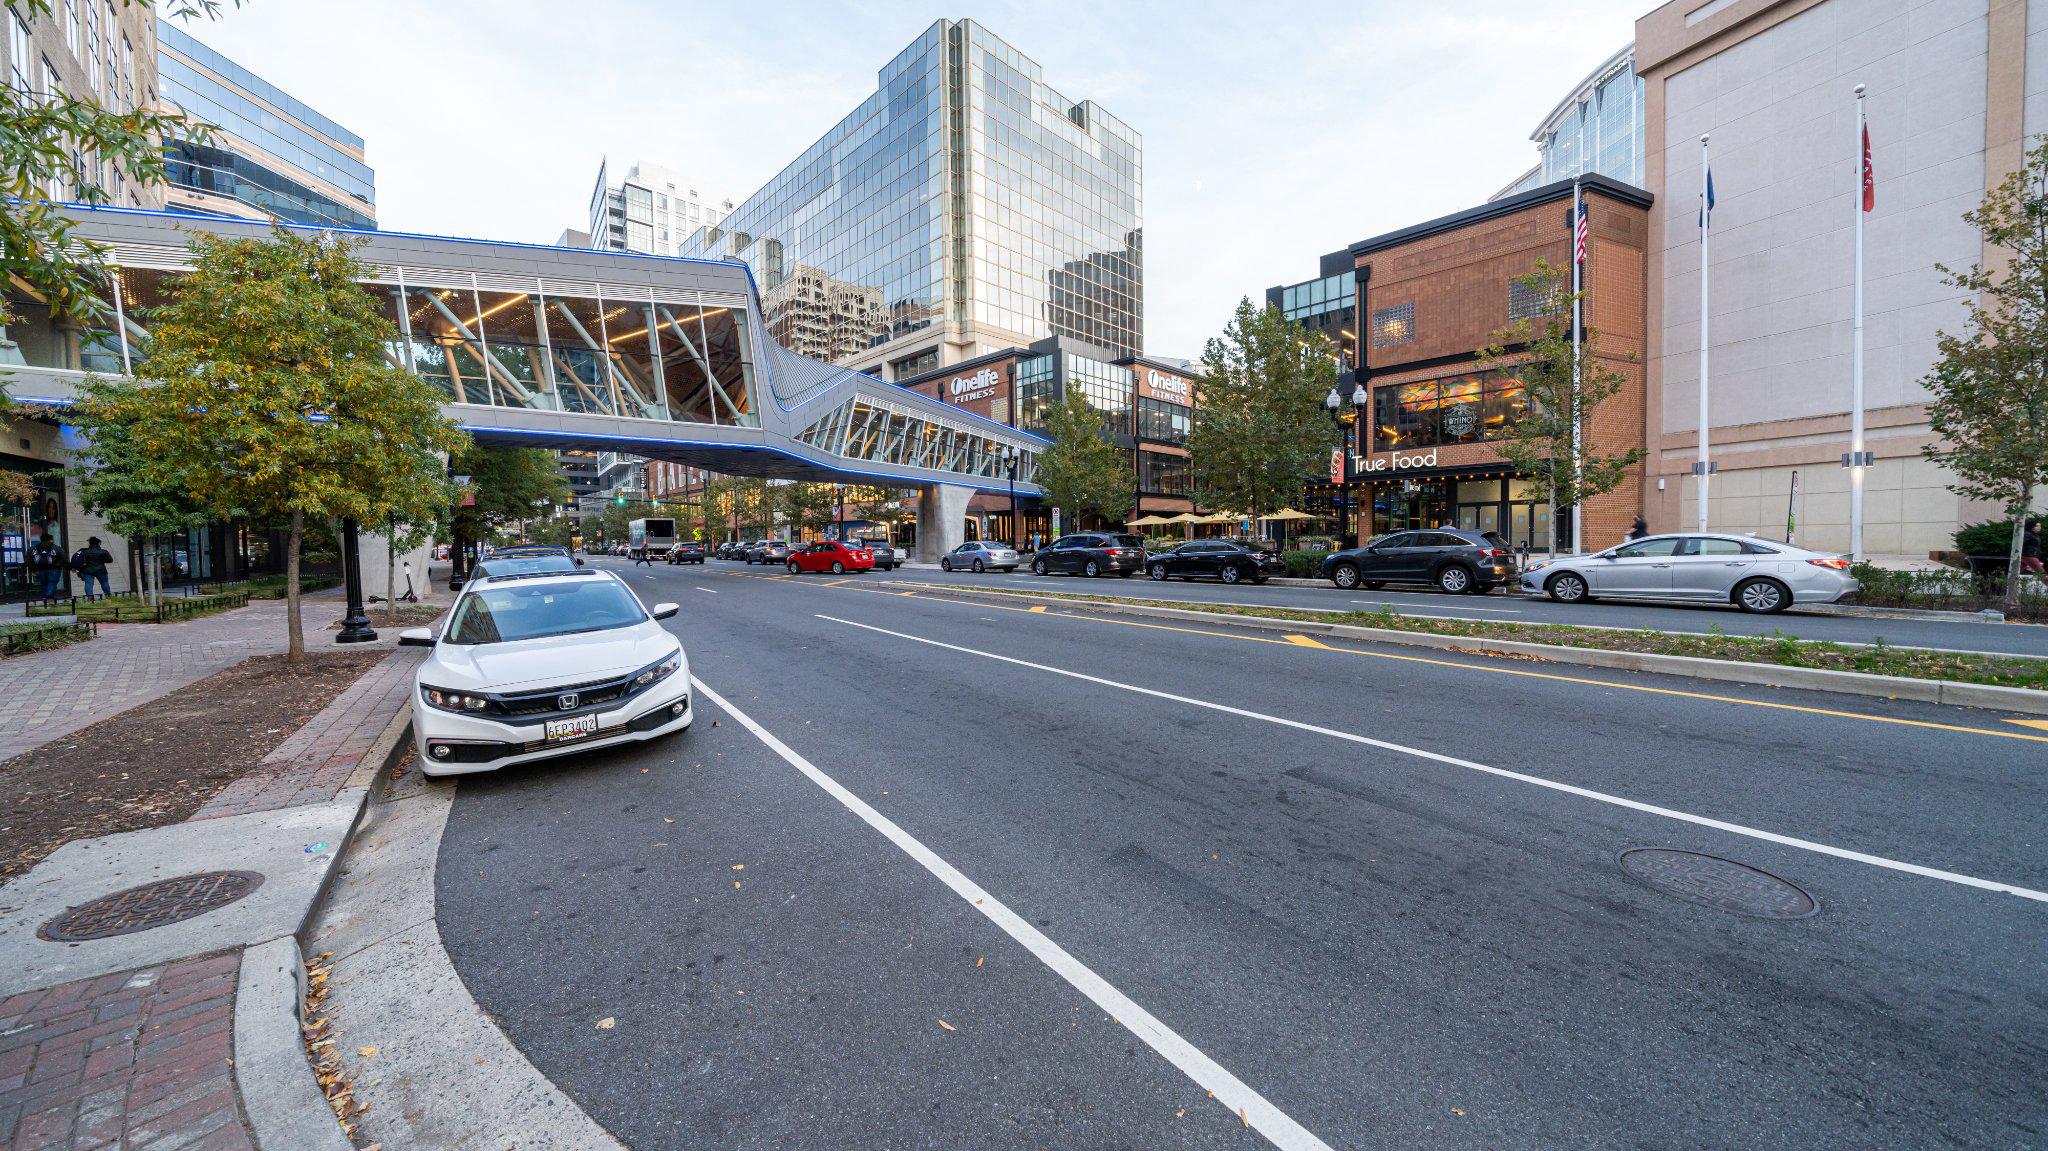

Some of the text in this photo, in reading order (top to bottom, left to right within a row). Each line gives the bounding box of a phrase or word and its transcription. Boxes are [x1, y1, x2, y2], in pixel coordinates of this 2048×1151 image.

[951, 368, 999, 396] Onelife
[1148, 370, 1188, 396] Onelife
[954, 387, 995, 404] FITNESS
[1151, 389, 1185, 404] FITNESS
[1352, 455, 1387, 474] True
[1392, 448, 1437, 471] Food
